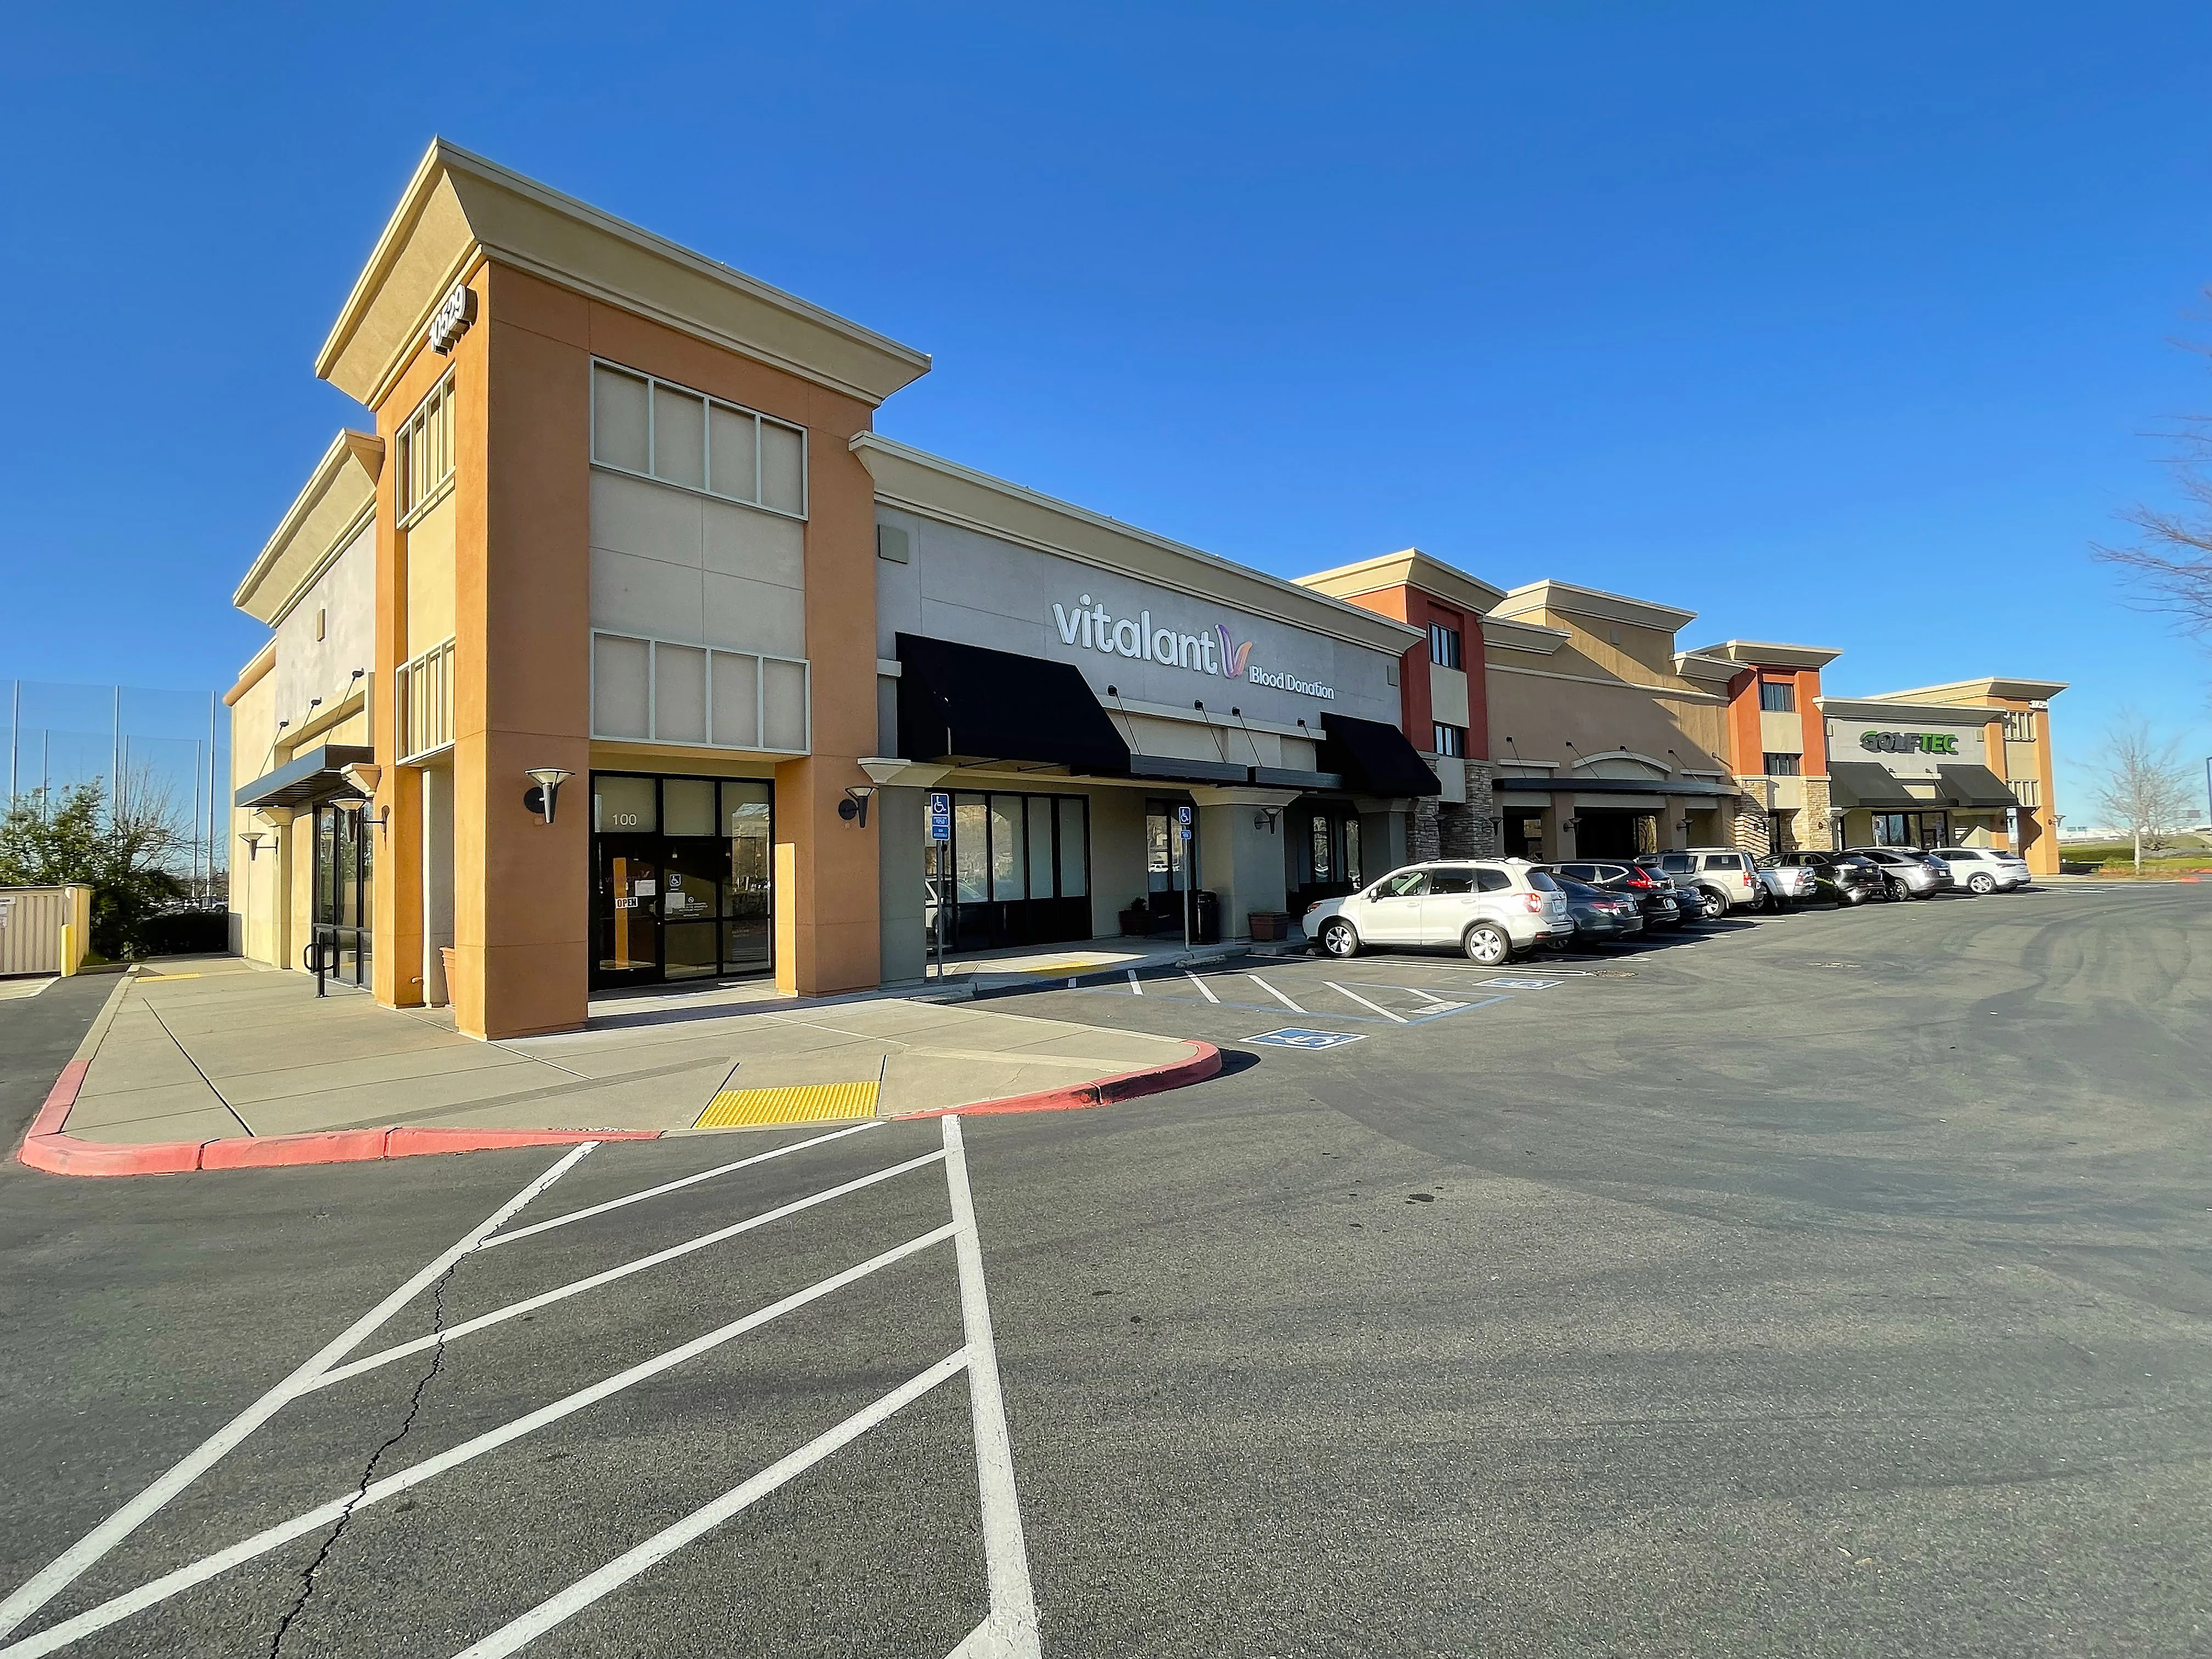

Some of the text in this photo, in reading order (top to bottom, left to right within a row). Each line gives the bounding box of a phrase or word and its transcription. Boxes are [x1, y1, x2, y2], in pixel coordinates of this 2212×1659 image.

[1052, 594, 1219, 675] vitalant
[1249, 665, 1335, 700] Blood Donation
[612, 814, 637, 826] 100
[617, 898, 637, 907] OPEN
